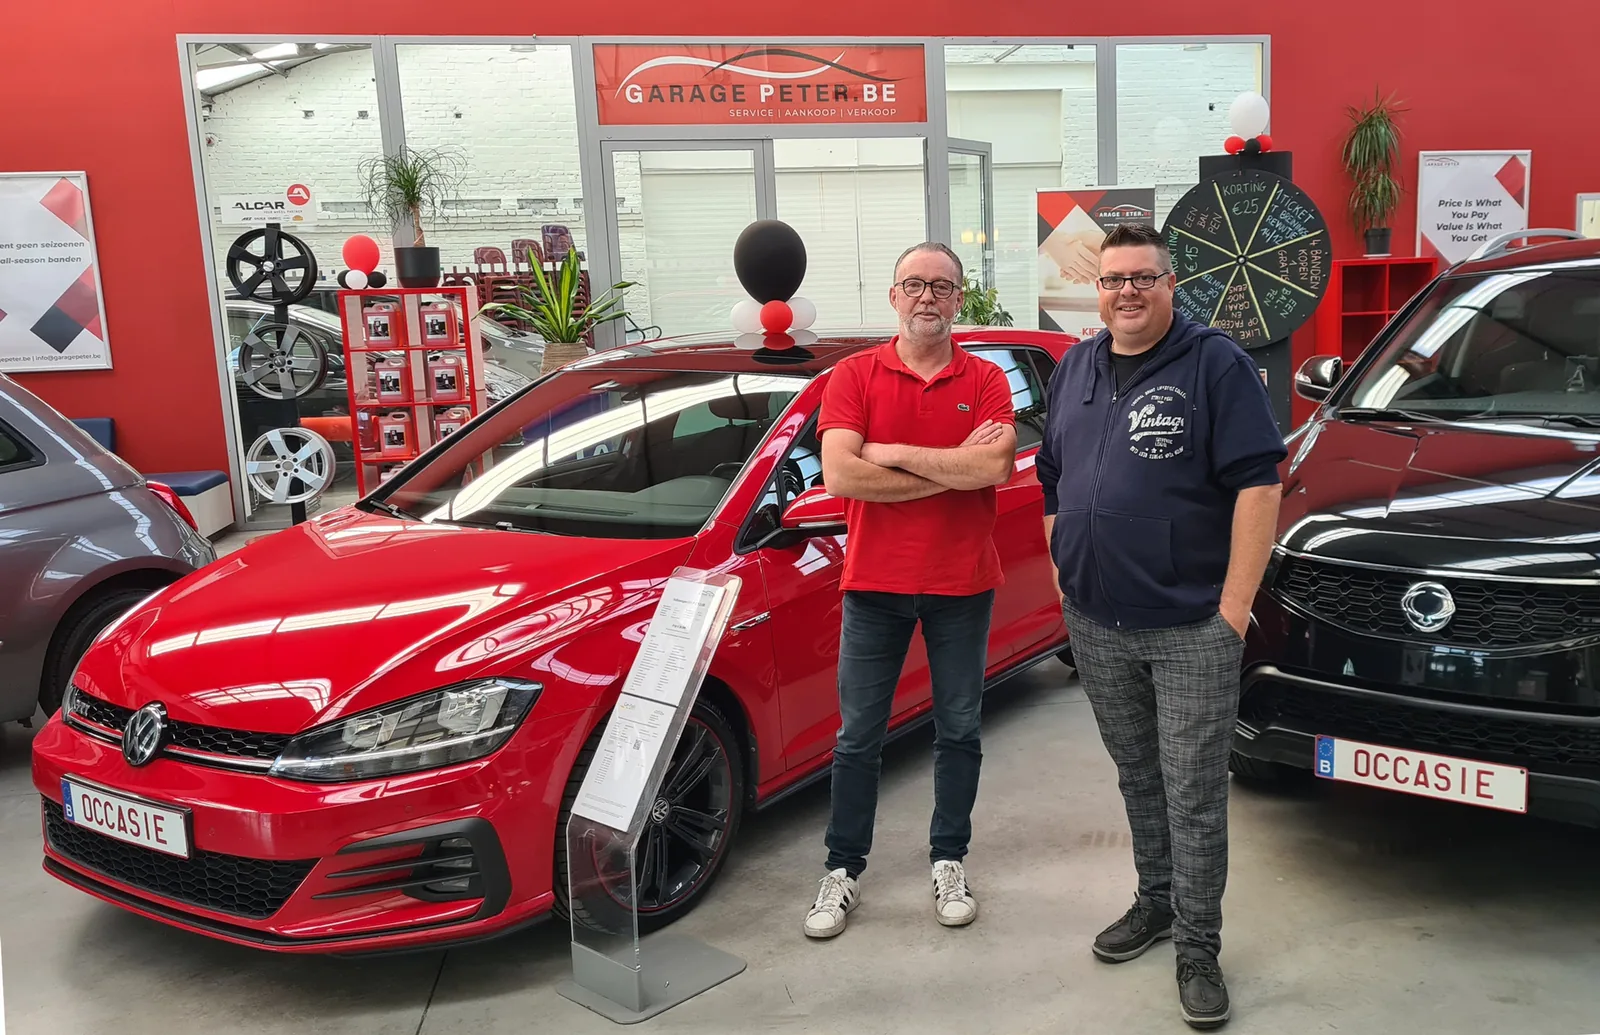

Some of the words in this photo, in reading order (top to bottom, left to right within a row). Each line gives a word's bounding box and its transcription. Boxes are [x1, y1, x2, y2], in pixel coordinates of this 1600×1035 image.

[625, 84, 745, 104] GARAGE
[760, 84, 897, 103] PETER.BE
[729, 109, 774, 117] SERVICE
[784, 109, 836, 117] AANKOOP
[847, 108, 897, 117] VERKOOP
[1222, 181, 1267, 196] KORTING
[232, 201, 285, 210] ALCAR
[1438, 199, 1463, 208] Price
[1465, 199, 1473, 208] Is
[1476, 199, 1502, 207] What
[1184, 206, 1198, 228] EEN
[1451, 211, 1468, 219] You
[1471, 211, 1489, 220] Pay
[1207, 212, 1223, 235] PEN
[1436, 222, 1463, 231] Value
[1466, 223, 1474, 231] Is
[1477, 222, 1503, 230] What
[1451, 234, 1468, 242] You
[1471, 233, 1488, 242] Get
[1297, 249, 1309, 280] KOPEN
[1310, 249, 1322, 290] BANDEN
[1192, 285, 1210, 304] VOOR
[1207, 287, 1220, 298] DE
[1226, 293, 1245, 304] NOG
[1263, 288, 1278, 307] PEN
[1179, 305, 1194, 320] EEN
[1280, 298, 1298, 318] EEN
[1248, 317, 1259, 327] OP
[1082, 327, 1104, 336] KIE
[1239, 328, 1261, 340] LIKE
[35, 353, 101, 362] info@garagepeter.be
[1320, 759, 1331, 773] B
[1354, 748, 1495, 800] OCCASIE
[65, 803, 73, 817] B
[81, 793, 168, 845] OCCASIE
